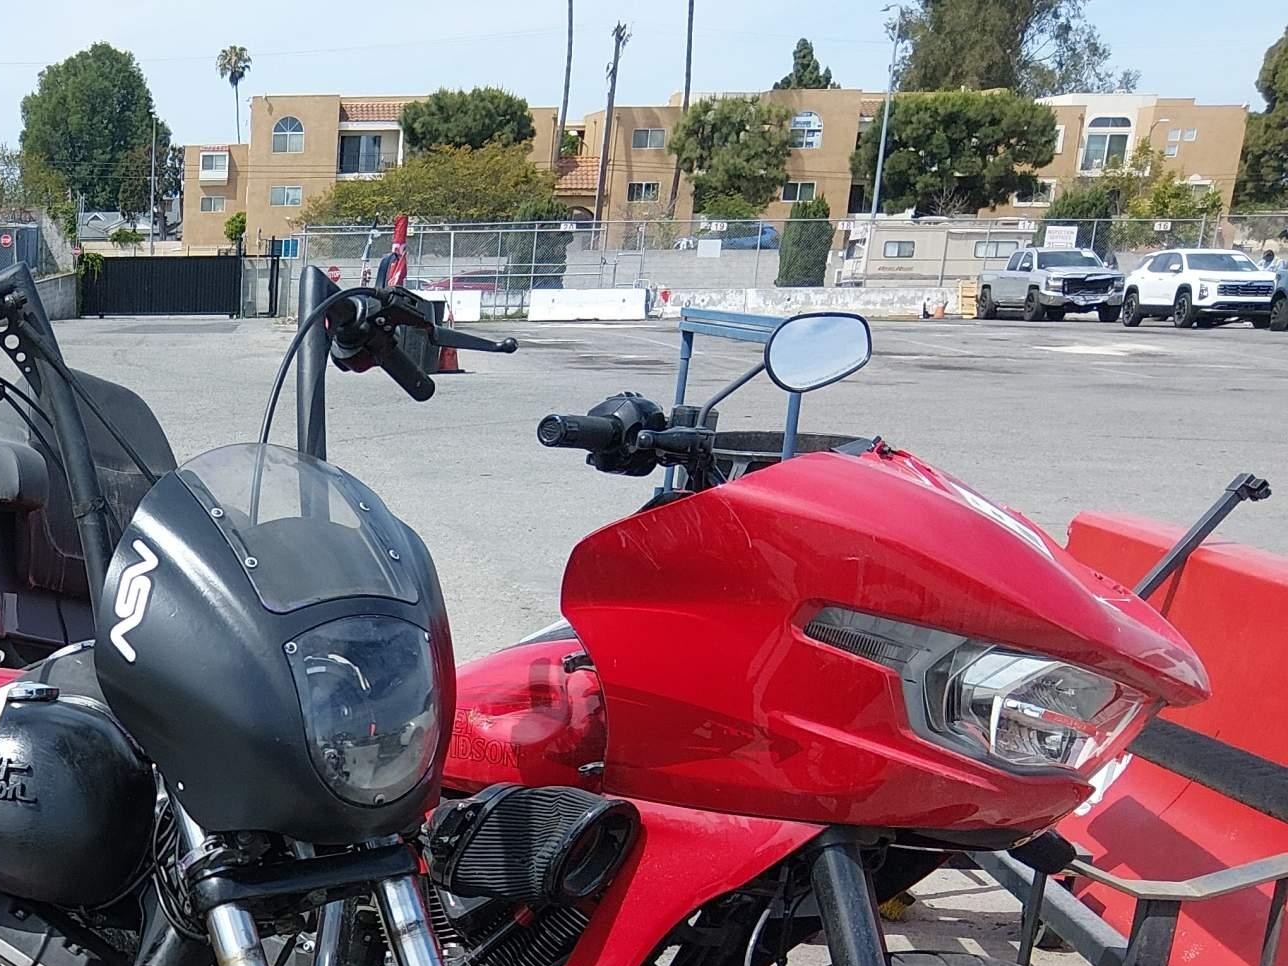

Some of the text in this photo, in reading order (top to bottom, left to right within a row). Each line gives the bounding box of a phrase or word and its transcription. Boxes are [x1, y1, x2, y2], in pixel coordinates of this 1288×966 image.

[714, 222, 725, 231] 19
[840, 221, 851, 230] 18
[1022, 221, 1032, 230] 17
[1157, 222, 1169, 230] 16
[450, 734, 521, 769] IDSON
